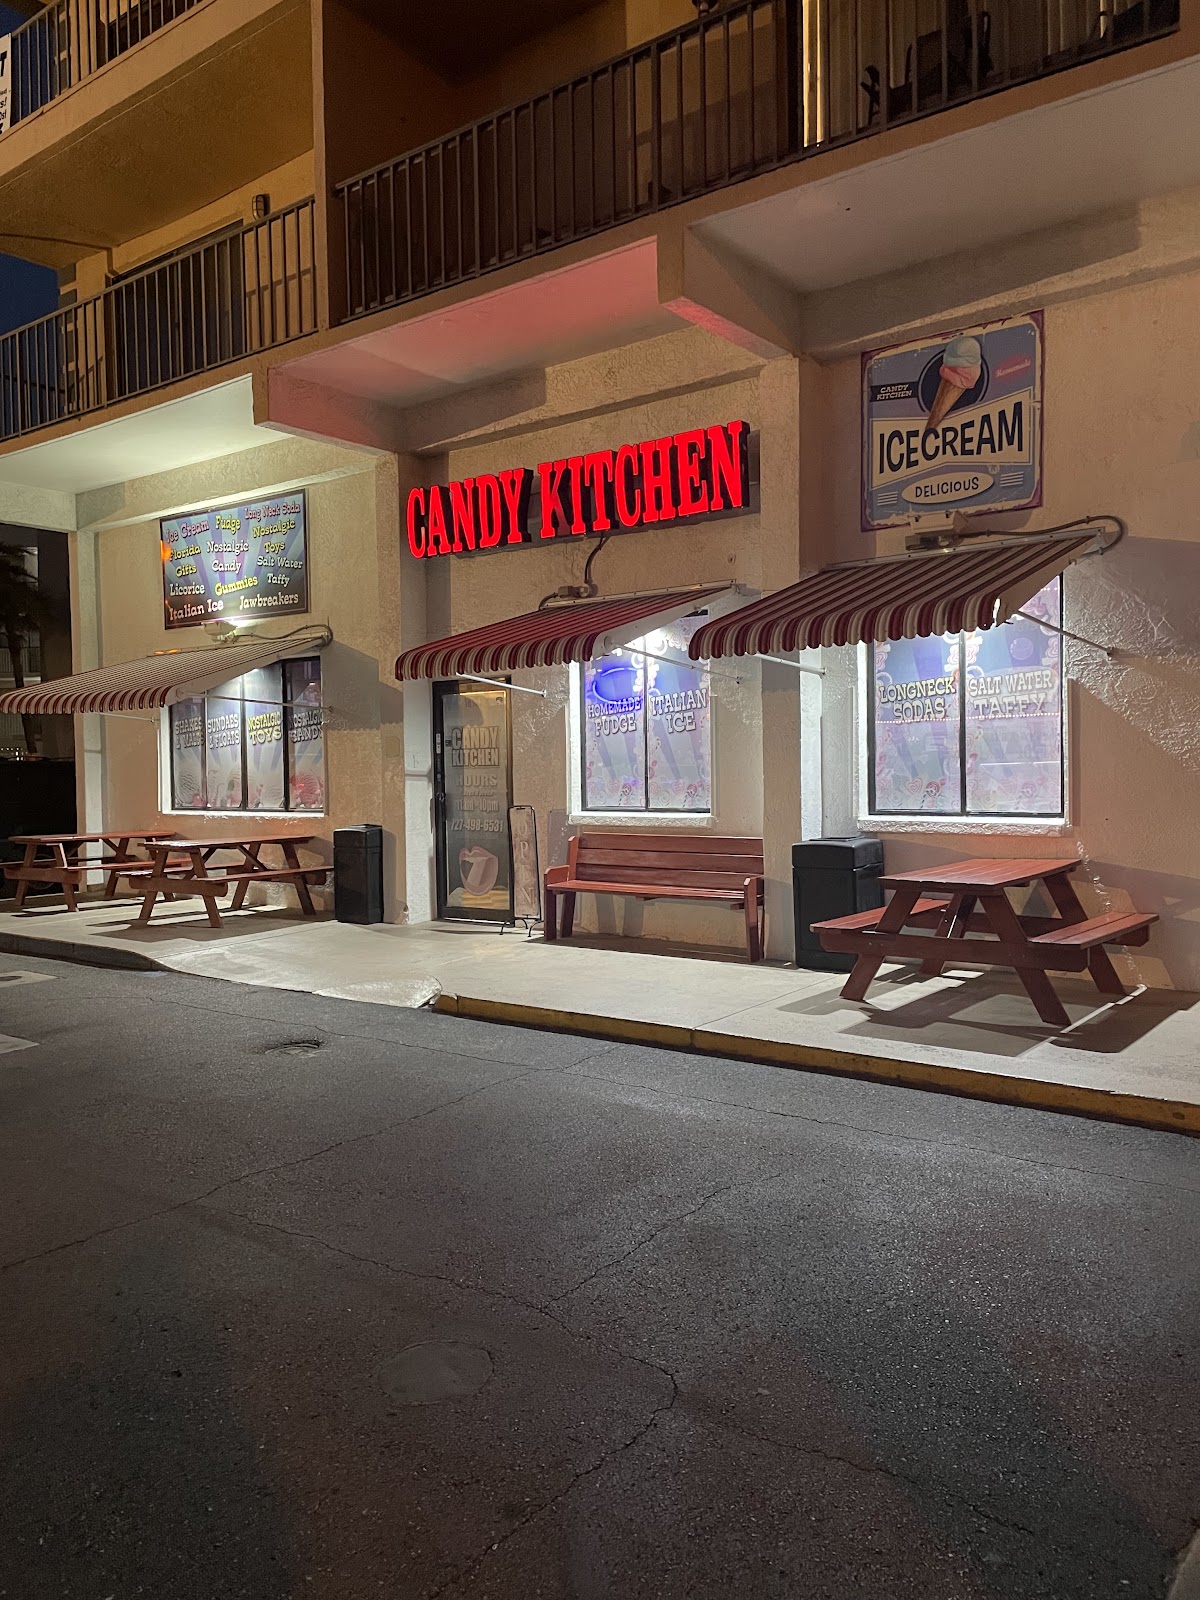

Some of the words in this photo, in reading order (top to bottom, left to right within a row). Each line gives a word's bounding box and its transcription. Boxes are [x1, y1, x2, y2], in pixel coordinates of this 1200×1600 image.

[877, 390, 912, 400] KITCHEN
[880, 384, 909, 392] CANDY
[406, 468, 528, 559] CANDY
[538, 420, 747, 539] KITCHEN
[915, 477, 979, 497] DELICIOUS
[244, 508, 261, 521] Long
[262, 505, 280, 518] Neck
[282, 502, 300, 514] Soda
[166, 529, 179, 542] Ice
[180, 520, 209, 538] Cream
[215, 515, 241, 535] Fudge
[253, 519, 295, 538] Nostalgic
[170, 545, 201, 561] Florida
[206, 540, 249, 555] Nostalgic
[264, 541, 285, 554] Toys
[176, 564, 197, 577] Gifts
[212, 560, 241, 574] Candy
[257, 556, 275, 567] Salt
[278, 557, 303, 569] Water
[170, 582, 205, 596] Licorice
[215, 576, 258, 596] Gummies
[267, 574, 290, 587] Taffy
[170, 604, 204, 620] Italian
[207, 599, 224, 612] Ice
[240, 592, 298, 610] Jawbreakers
[879, 676, 956, 703] LONGNECK
[969, 675, 1001, 697] SALT
[1005, 670, 1052, 692] WATER
[588, 697, 641, 718] HOMEMADE
[650, 688, 707, 716] ITALIAN
[893, 698, 946, 723] SODAS
[974, 693, 1046, 720] TAFFY
[175, 717, 202, 734] SHAKES
[207, 713, 239, 733] SUNDAES
[248, 711, 281, 730] NOSTALGIC
[594, 713, 636, 736] FUDGE
[666, 712, 696, 734] ICE
[209, 737, 214, 749] &
[216, 729, 240, 748] FLOATS
[250, 726, 282, 745] TOYS
[451, 726, 499, 749] CANDY
[452, 749, 499, 767] KITCHEN
[457, 774, 498, 787] HOURS
[451, 819, 504, 832] 727-498-6531
[518, 821, 535, 909] OPEN
